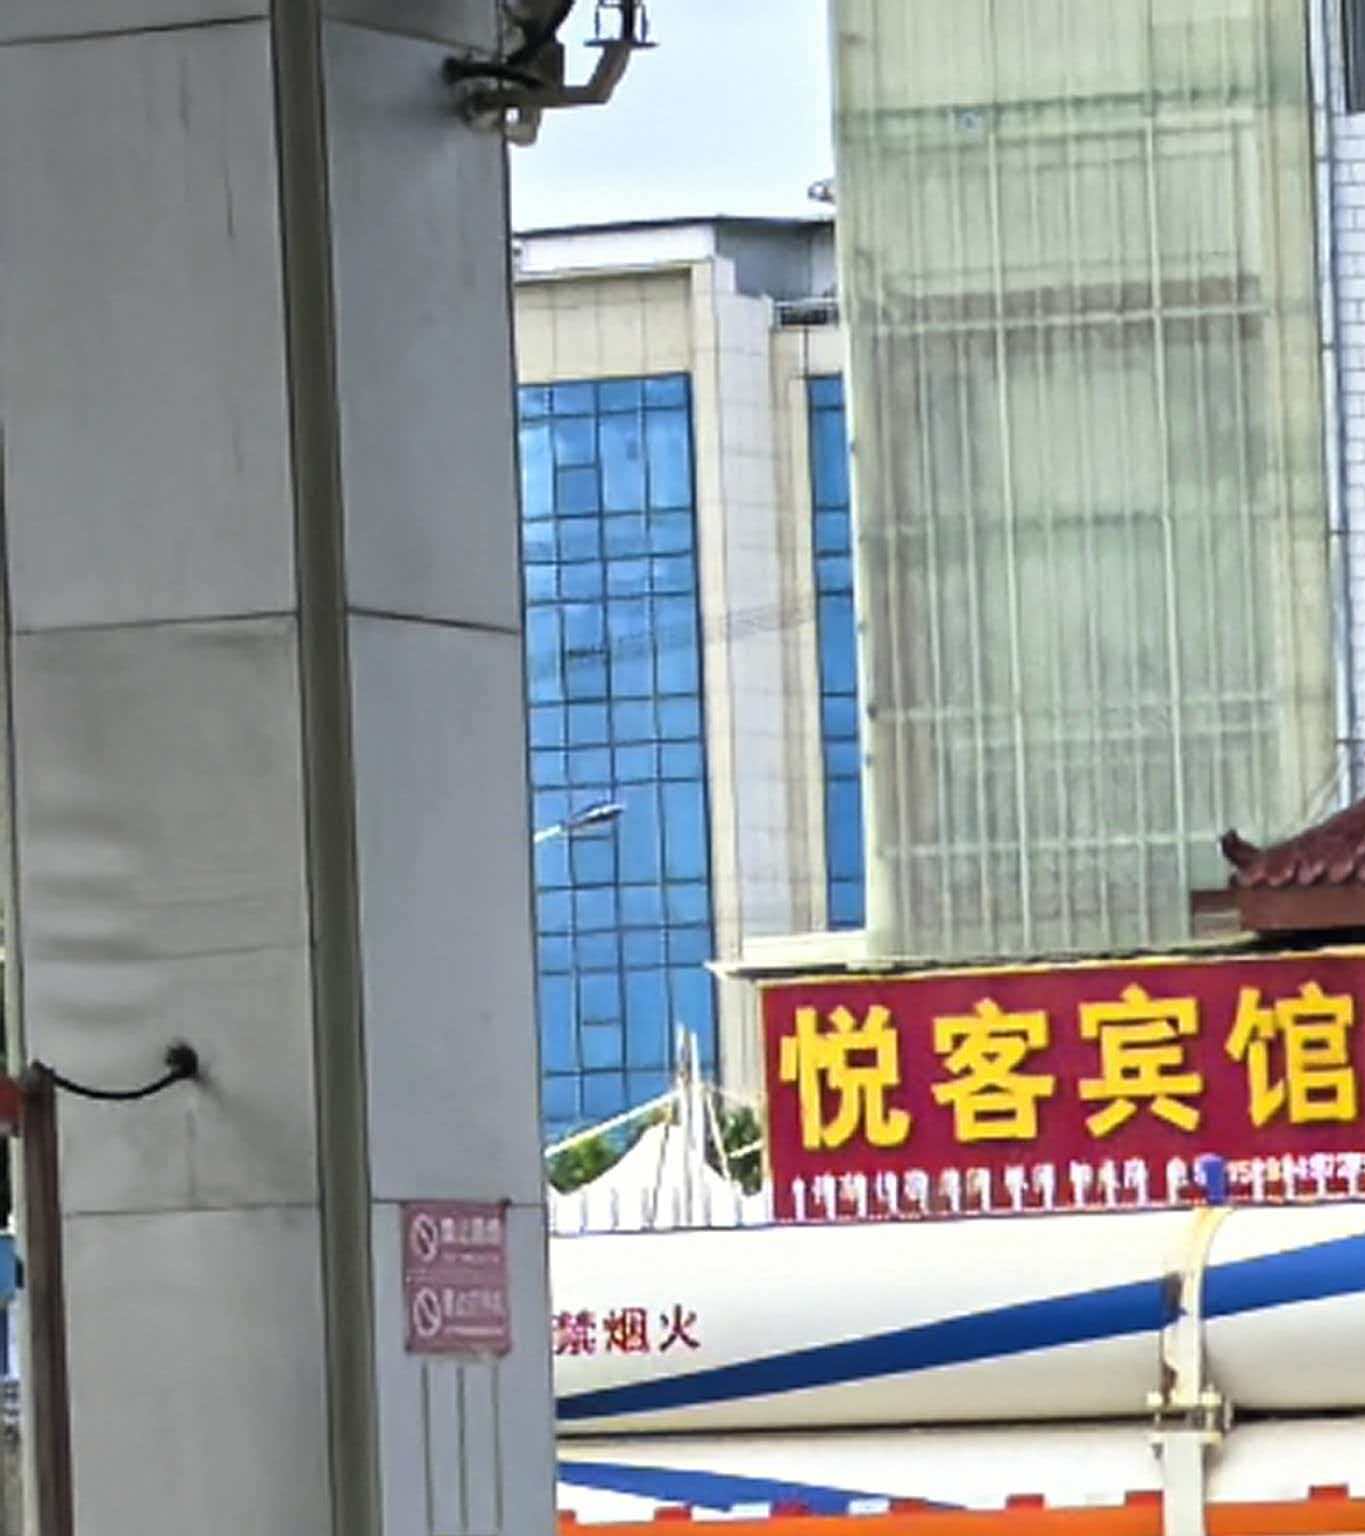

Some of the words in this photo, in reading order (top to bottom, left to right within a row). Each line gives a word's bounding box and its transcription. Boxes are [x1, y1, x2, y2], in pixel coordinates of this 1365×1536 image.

[779, 979, 1358, 1151] 悦客宾馆
[551, 1303, 701, 1356] 禁烟火
